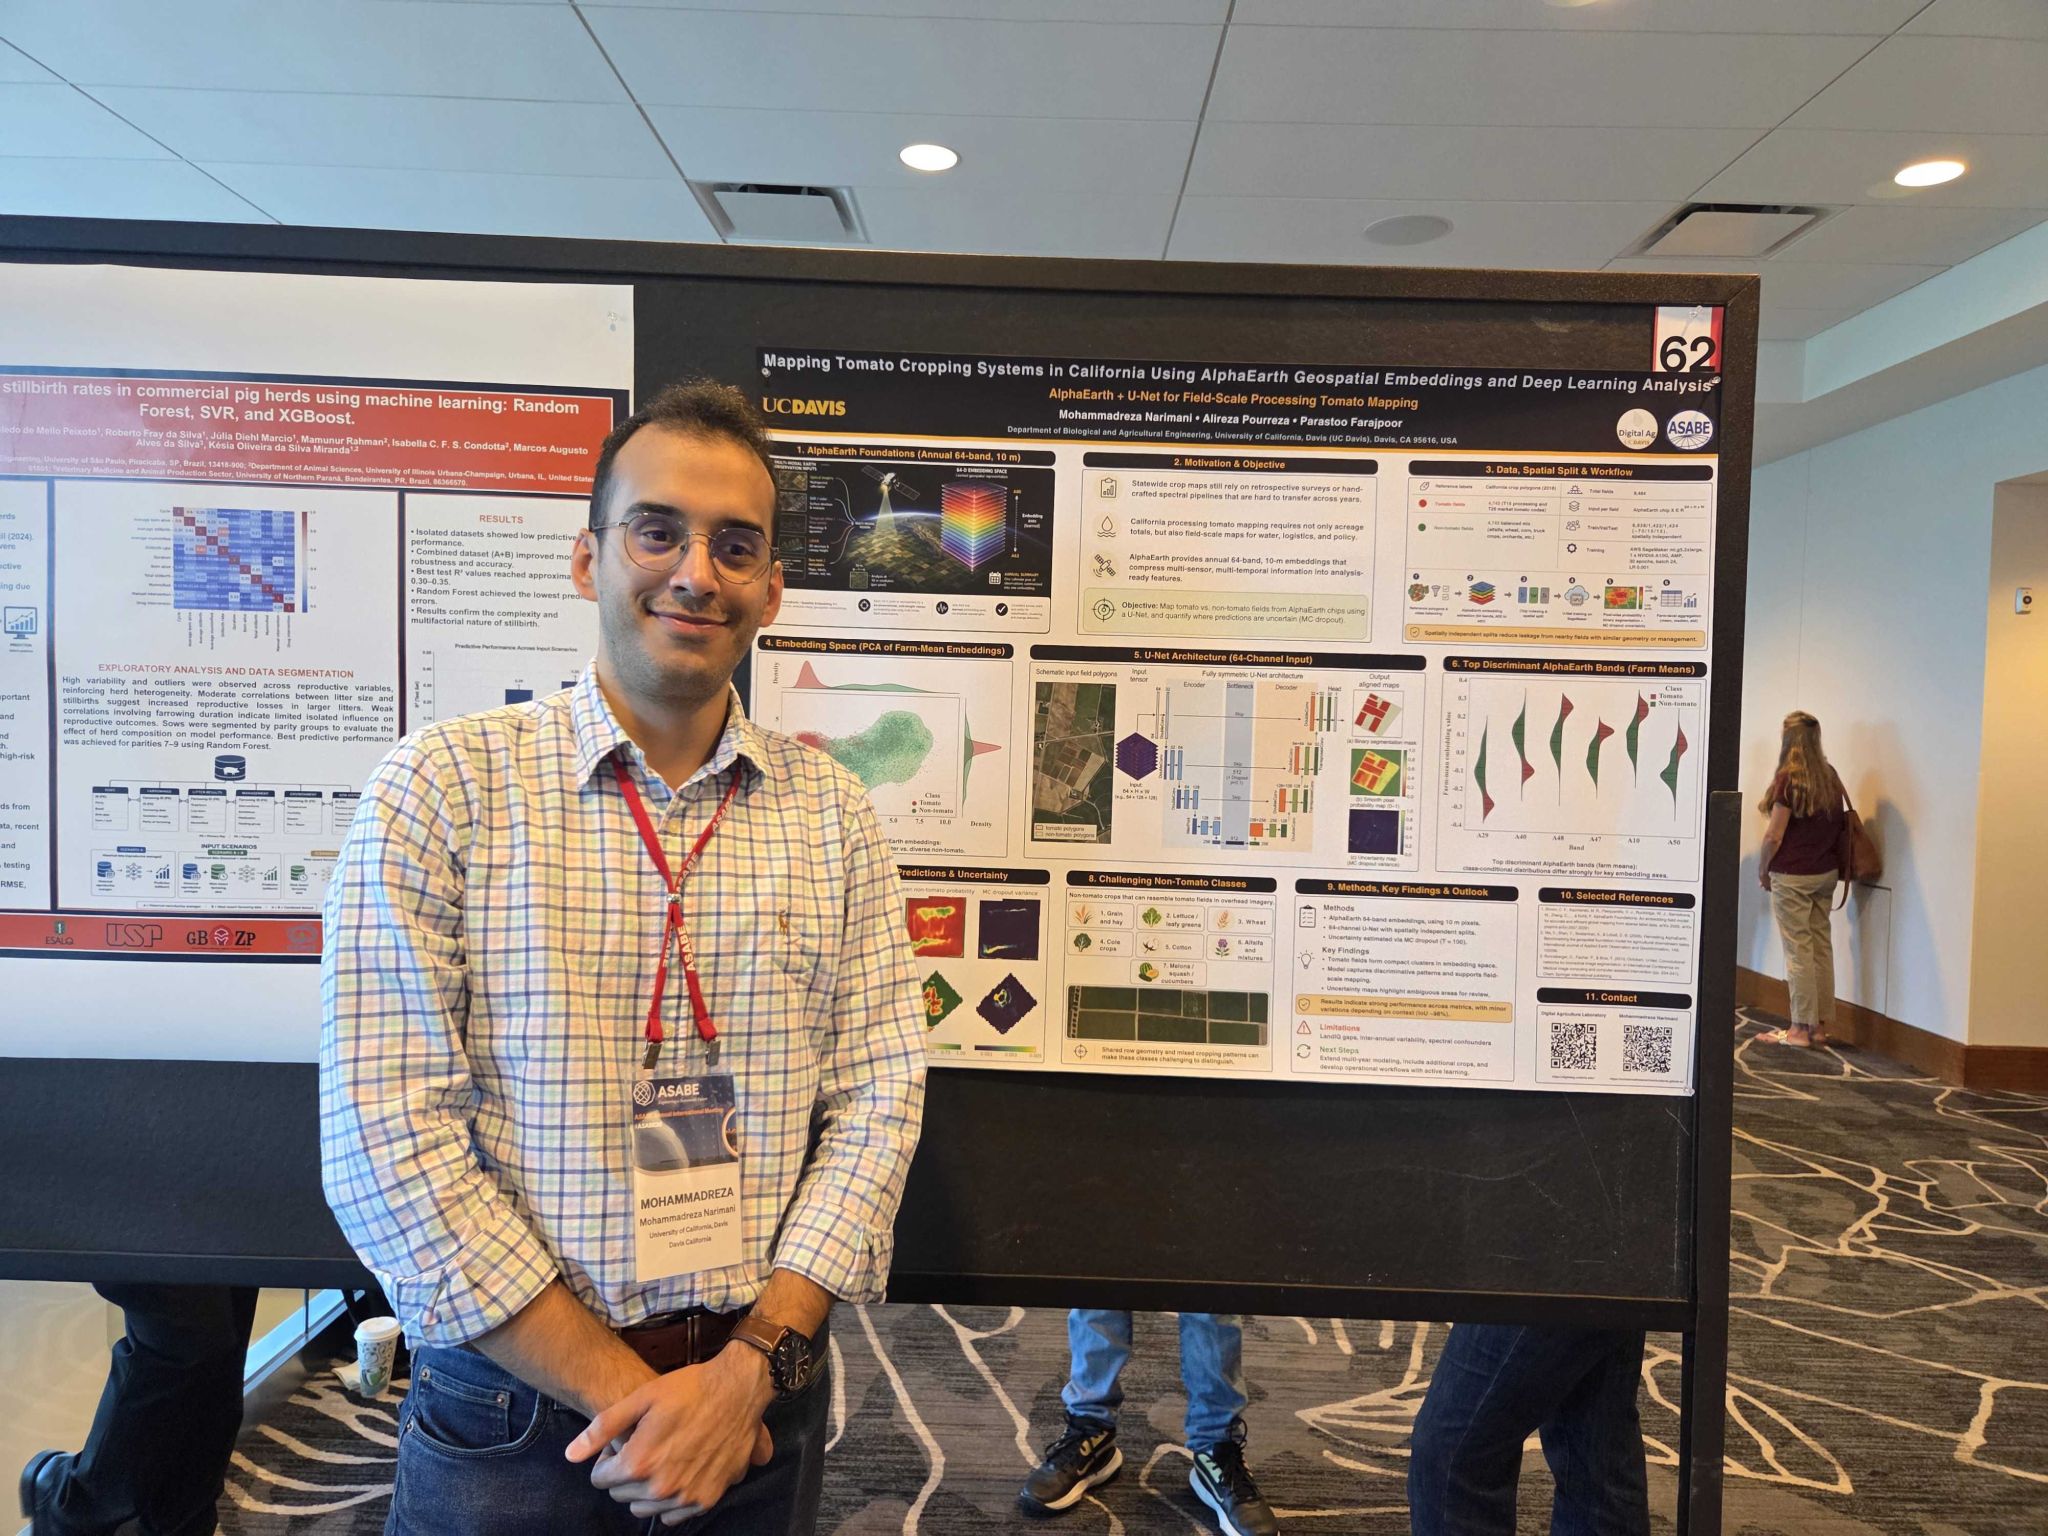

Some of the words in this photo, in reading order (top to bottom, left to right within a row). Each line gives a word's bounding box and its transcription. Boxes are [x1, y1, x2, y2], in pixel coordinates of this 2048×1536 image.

[1660, 336, 1716, 372] 62
[763, 354, 830, 372] Mapping
[838, 356, 894, 370] Tomato
[899, 359, 971, 376] Cropping
[977, 362, 1043, 376] Systems
[1049, 363, 1062, 376] in
[1068, 364, 1145, 378] California
[1151, 367, 1195, 383] Using
[1200, 368, 1288, 382] AlphaEarth
[1294, 370, 1379, 385] Geospatial
[1384, 372, 1482, 389] Embeddings
[1487, 375, 1517, 387] and
[1522, 375, 1562, 390] Deep
[1567, 377, 1637, 393] Learning
[1641, 378, 1714, 393] Analysis
[2, 380, 67, 394] stillbirth
[72, 383, 114, 395] rates
[115, 386, 131, 396] in
[136, 386, 228, 398] commercial
[234, 387, 259, 403] pig
[265, 388, 310, 402] herds
[316, 391, 359, 407] using
[365, 394, 432, 407] machine
[438, 395, 507, 413] learning:
[513, 398, 578, 413] Random
[1048, 388, 1113, 400] AlphaEarth
[1127, 390, 1160, 401] U-Net
[1162, 391, 1180, 401] for
[1182, 392, 1247, 403] Field-Scale
[1250, 394, 1316, 407] Processing
[1319, 395, 1364, 406] Tomato
[1367, 396, 1418, 410] Mapping
[138, 403, 194, 419] Forest,
[199, 405, 239, 421] SVR,
[243, 408, 273, 420] and
[278, 408, 354, 424] XGBoost.
[1059, 409, 1142, 420] Mohammadreza
[1145, 412, 1192, 422] Narimani
[1202, 413, 1239, 423] Alireza
[1242, 414, 1289, 424] Pourreza
[1300, 416, 1347, 426] Parastoo
[1350, 417, 1402, 428] Farajpoor
[1062, 427, 1100, 436] Biological
[1214, 432, 1253, 440] University
[1618, 429, 1643, 439] Digital
[1645, 430, 1656, 441] Ag
[1668, 420, 1710, 436] ASABE
[807, 446, 856, 455] AlphaEarth
[859, 448, 914, 456] Foundations
[917, 450, 952, 458] (Annual
[954, 451, 993, 460] 64-band,
[1008, 453, 1020, 462] m)
[1184, 458, 1231, 466] Motivation
[1242, 460, 1285, 469] Objective
[1522, 466, 1555, 474] Spatial
[1557, 466, 1578, 475] Split
[1590, 467, 1633, 475] Workflow
[479, 514, 523, 523] RESULTS
[496, 610, 541, 618] complexity
[775, 639, 826, 650] Embedding
[828, 641, 856, 650] Space
[858, 642, 881, 651] (PCA
[894, 643, 944, 652] Farm-Mean
[946, 645, 1005, 655] Embeddings)
[1171, 652, 1226, 660] Architecture
[1228, 654, 1283, 662] (64-Channel
[1285, 655, 1312, 664] Input)
[97, 663, 171, 672] EXPLORATORY
[173, 666, 222, 674] ANALYSIS
[277, 668, 353, 677] SEGMENTATION
[1462, 660, 1480, 669] Top
[1482, 660, 1540, 669] Discriminant
[1542, 662, 1593, 671] AlphaEarth
[1595, 663, 1625, 671] Bands
[1627, 664, 1656, 673] (Farm
[1658, 665, 1695, 674] Means)
[897, 868, 946, 878] Predictions
[957, 870, 1008, 880] Uncertainty
[1098, 874, 1152, 885] Challenging
[1154, 877, 1208, 886] Non-Tomato
[1210, 878, 1246, 887] Classes
[1337, 883, 1379, 892] Methods,
[1381, 884, 1399, 894] Key
[1401, 885, 1440, 895] Findings
[1451, 887, 1488, 895] Outlook
[1576, 891, 1616, 900] Selected
[1618, 893, 1673, 903] References
[105, 923, 164, 947] USP
[679, 926, 696, 971] ASABE
[1585, 992, 1598, 1001] 11.
[1600, 993, 1637, 1002] Contact
[658, 1083, 700, 1097] ASABE
[641, 1187, 734, 1209] MOHAMMADREZA
[639, 1211, 702, 1226] Mohammadreza
[703, 1204, 736, 1216] Narimani
[649, 1229, 678, 1238] University
[685, 1236, 711, 1245] California
